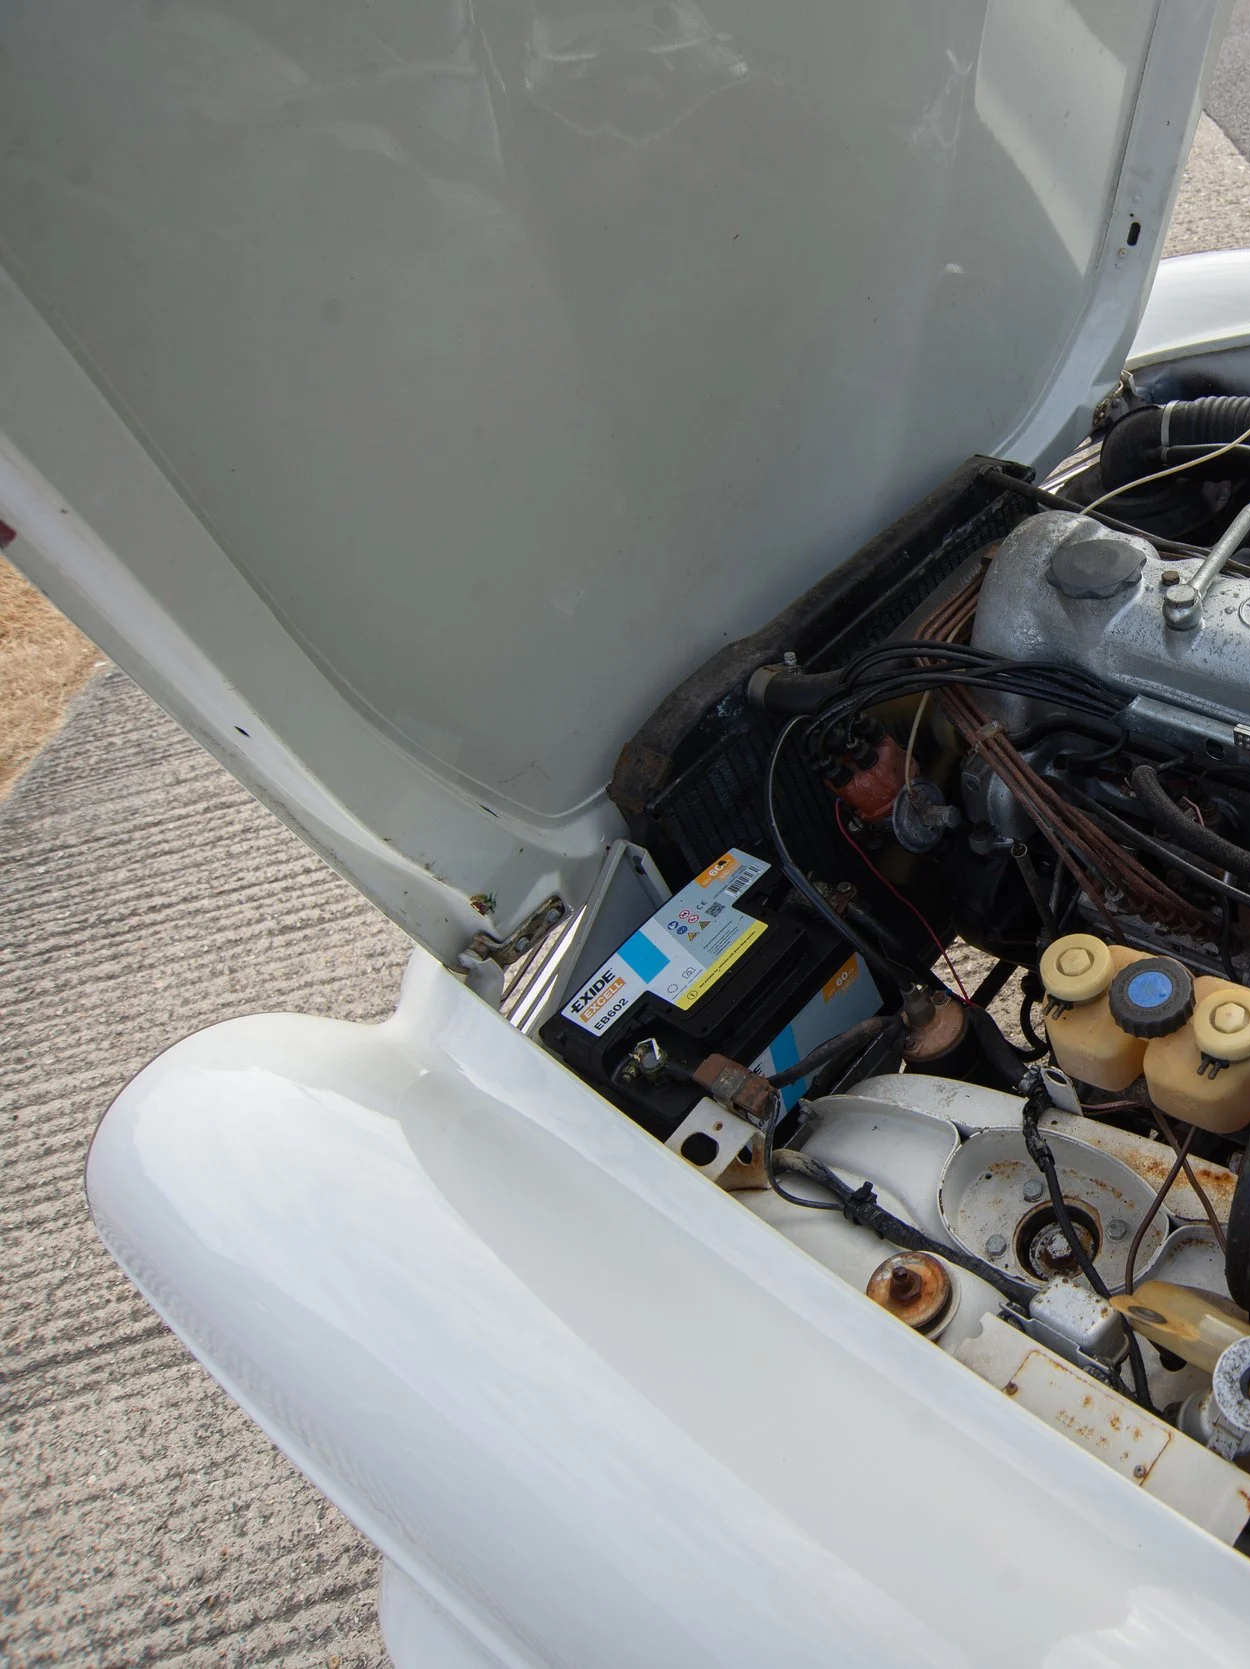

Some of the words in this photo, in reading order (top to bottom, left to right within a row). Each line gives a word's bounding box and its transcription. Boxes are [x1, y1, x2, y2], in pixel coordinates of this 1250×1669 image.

[570, 968, 616, 1014] EXIDE
[836, 971, 848, 987] 60
[583, 981, 625, 1019] EXCELL
[593, 998, 629, 1031] EB602
